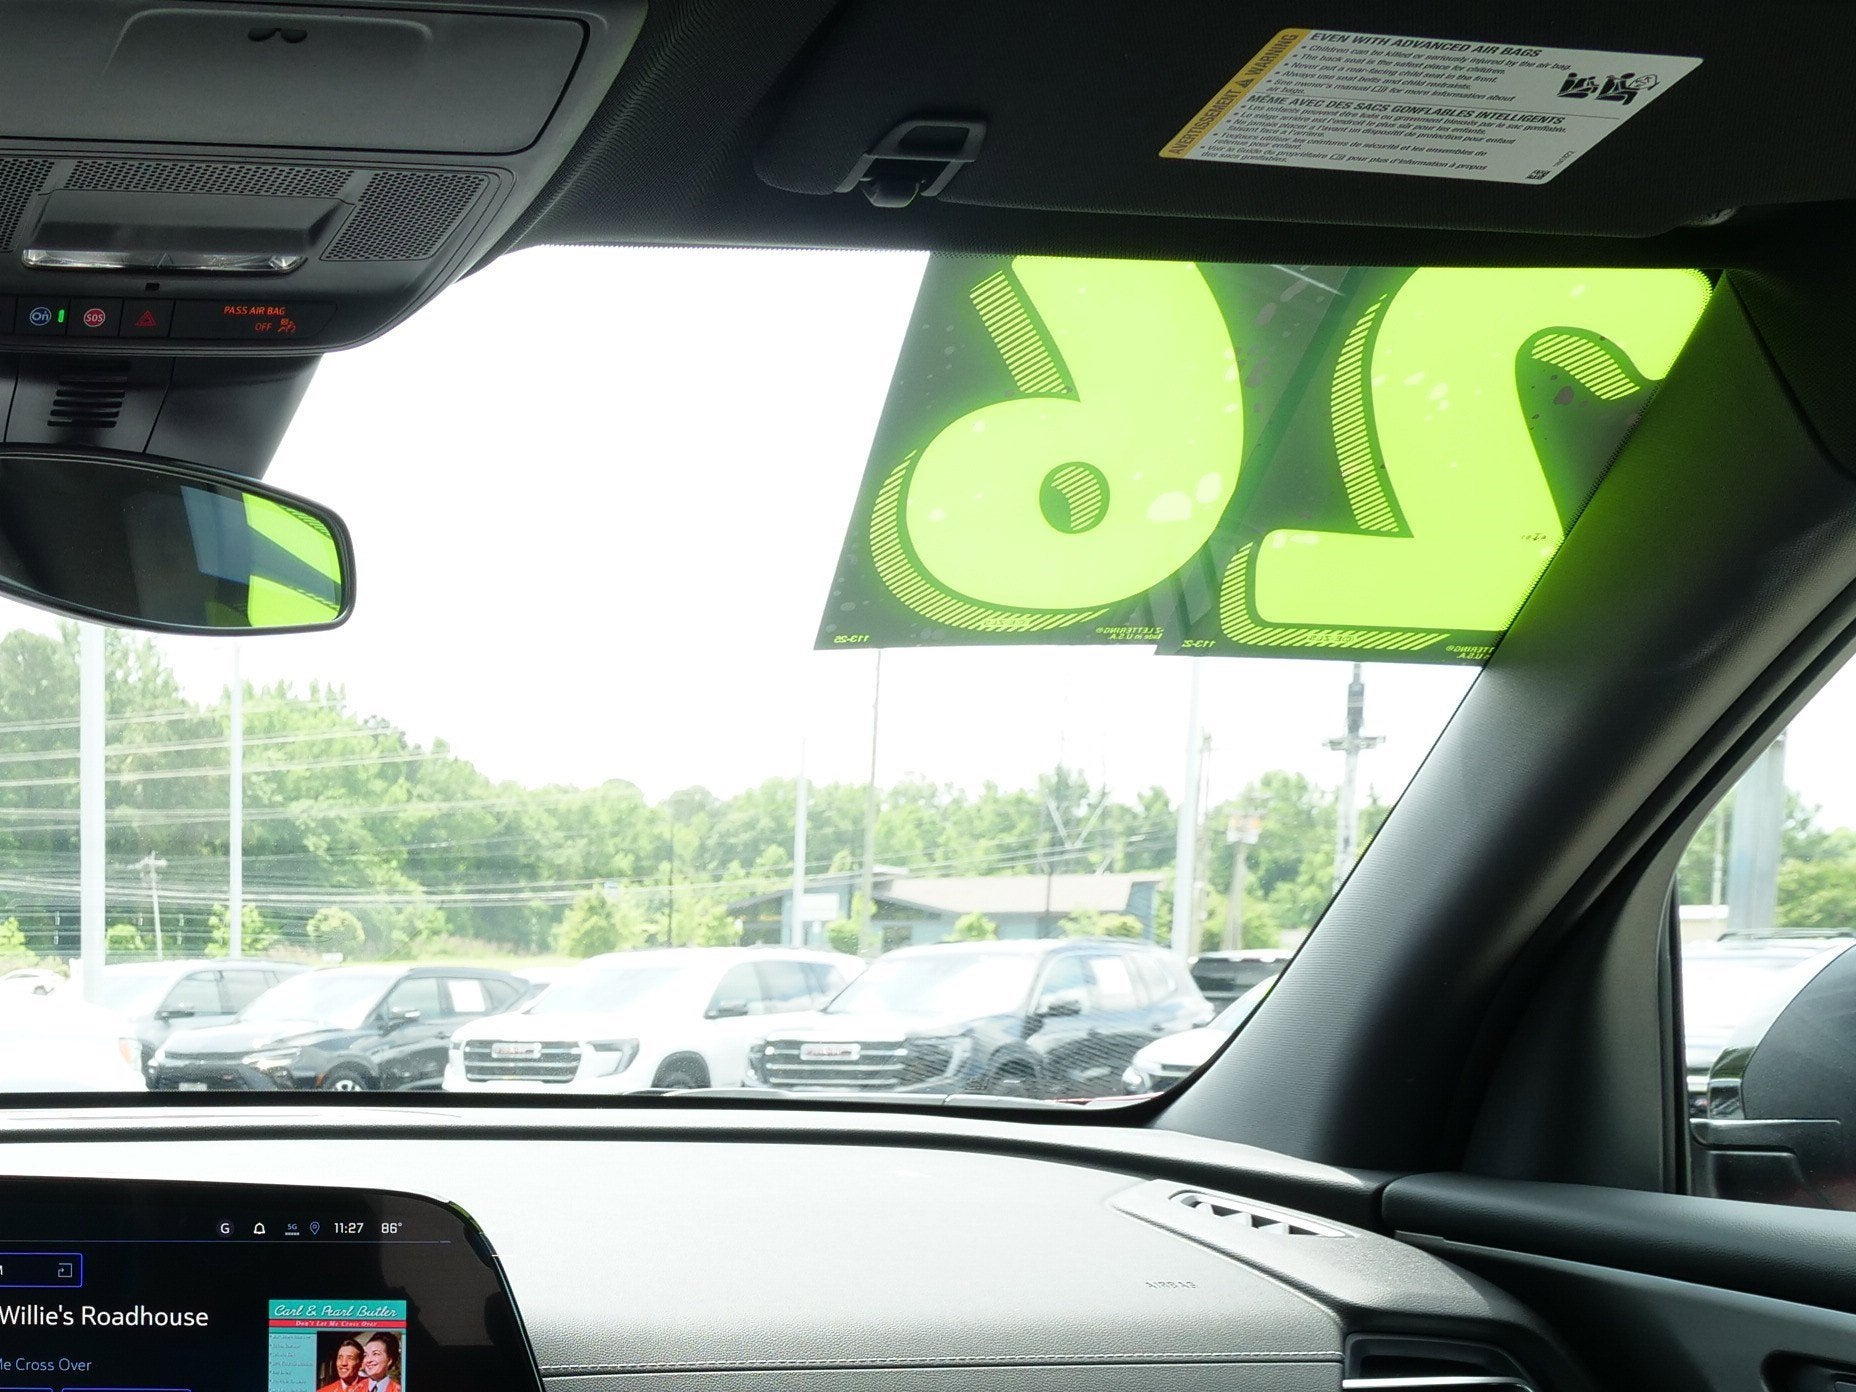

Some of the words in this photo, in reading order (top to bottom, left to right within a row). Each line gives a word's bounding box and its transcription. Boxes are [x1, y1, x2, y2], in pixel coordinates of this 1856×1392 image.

[1310, 32, 1350, 43] EVEN
[1352, 36, 1390, 46] WITH
[1391, 38, 1471, 51] ADVANCED
[1472, 45, 1499, 55] AIR
[1500, 47, 1543, 57] BAGS
[1244, 34, 1299, 76] WARNING
[1246, 94, 1289, 105] MÊME
[1289, 98, 1326, 108] AVEC
[1325, 100, 1354, 110] DES
[1354, 102, 1391, 112] SACS
[1391, 106, 1475, 118] GONFLABLES
[1474, 110, 1566, 125] INTELLIGENTS
[1168, 88, 1242, 155] AVERTISSEMENT
[224, 306, 248, 315] PASS
[250, 307, 266, 315] AIR
[267, 307, 286, 315] BAG
[85, 313, 104, 322] SOS
[256, 323, 272, 331] OFF
[334, 1223, 364, 1234] 11:27
[381, 1222, 403, 1234] 86°
[81, 1306, 209, 1326] Roadhouse
[274, 1305, 304, 1317] Carl
[306, 1306, 317, 1316] &
[322, 1305, 353, 1317] Pearl
[357, 1306, 398, 1317] Butler
[15, 1358, 54, 1371] Cross
[58, 1358, 92, 1371] Over
